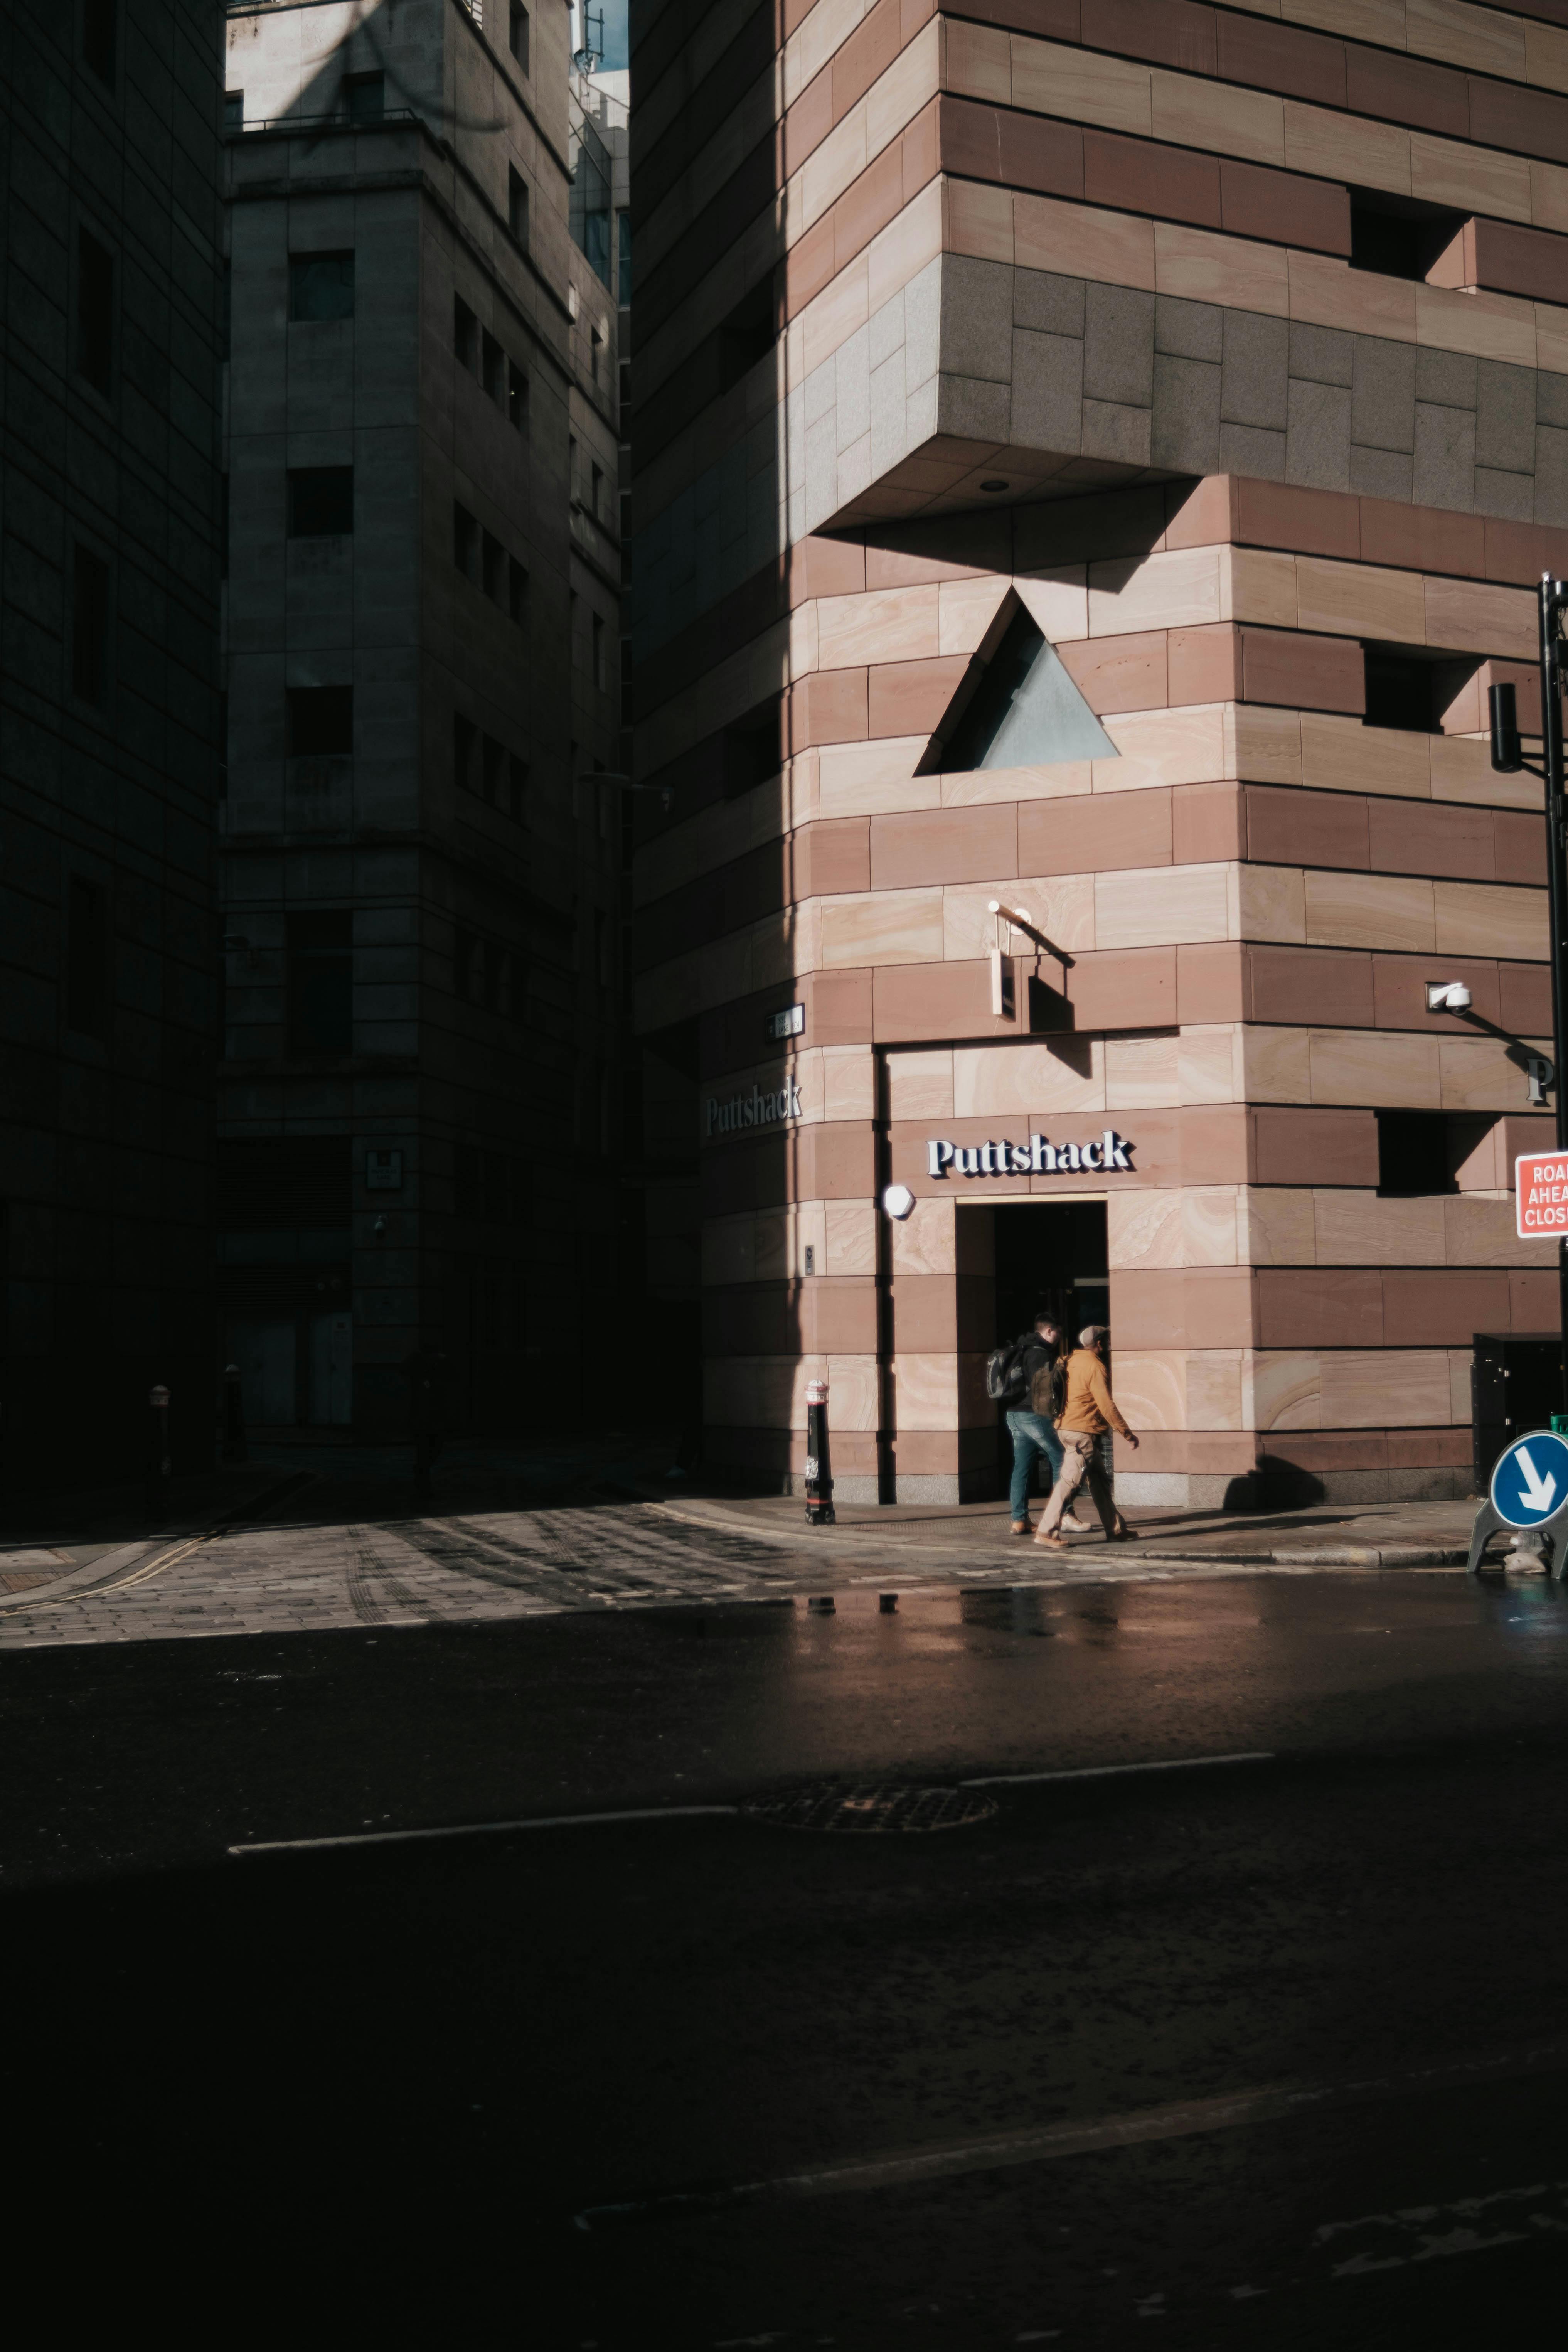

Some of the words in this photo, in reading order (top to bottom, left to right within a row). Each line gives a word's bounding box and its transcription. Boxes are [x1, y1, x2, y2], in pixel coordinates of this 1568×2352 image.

[778, 1015, 786, 1024] SISE
[778, 1024, 789, 1034] LANE
[706, 1074, 803, 1137] Puttshack
[926, 1130, 1129, 1175] Puttshack
[1533, 1164, 1568, 1183] ROA
[1525, 1207, 1568, 1226] CLOS
